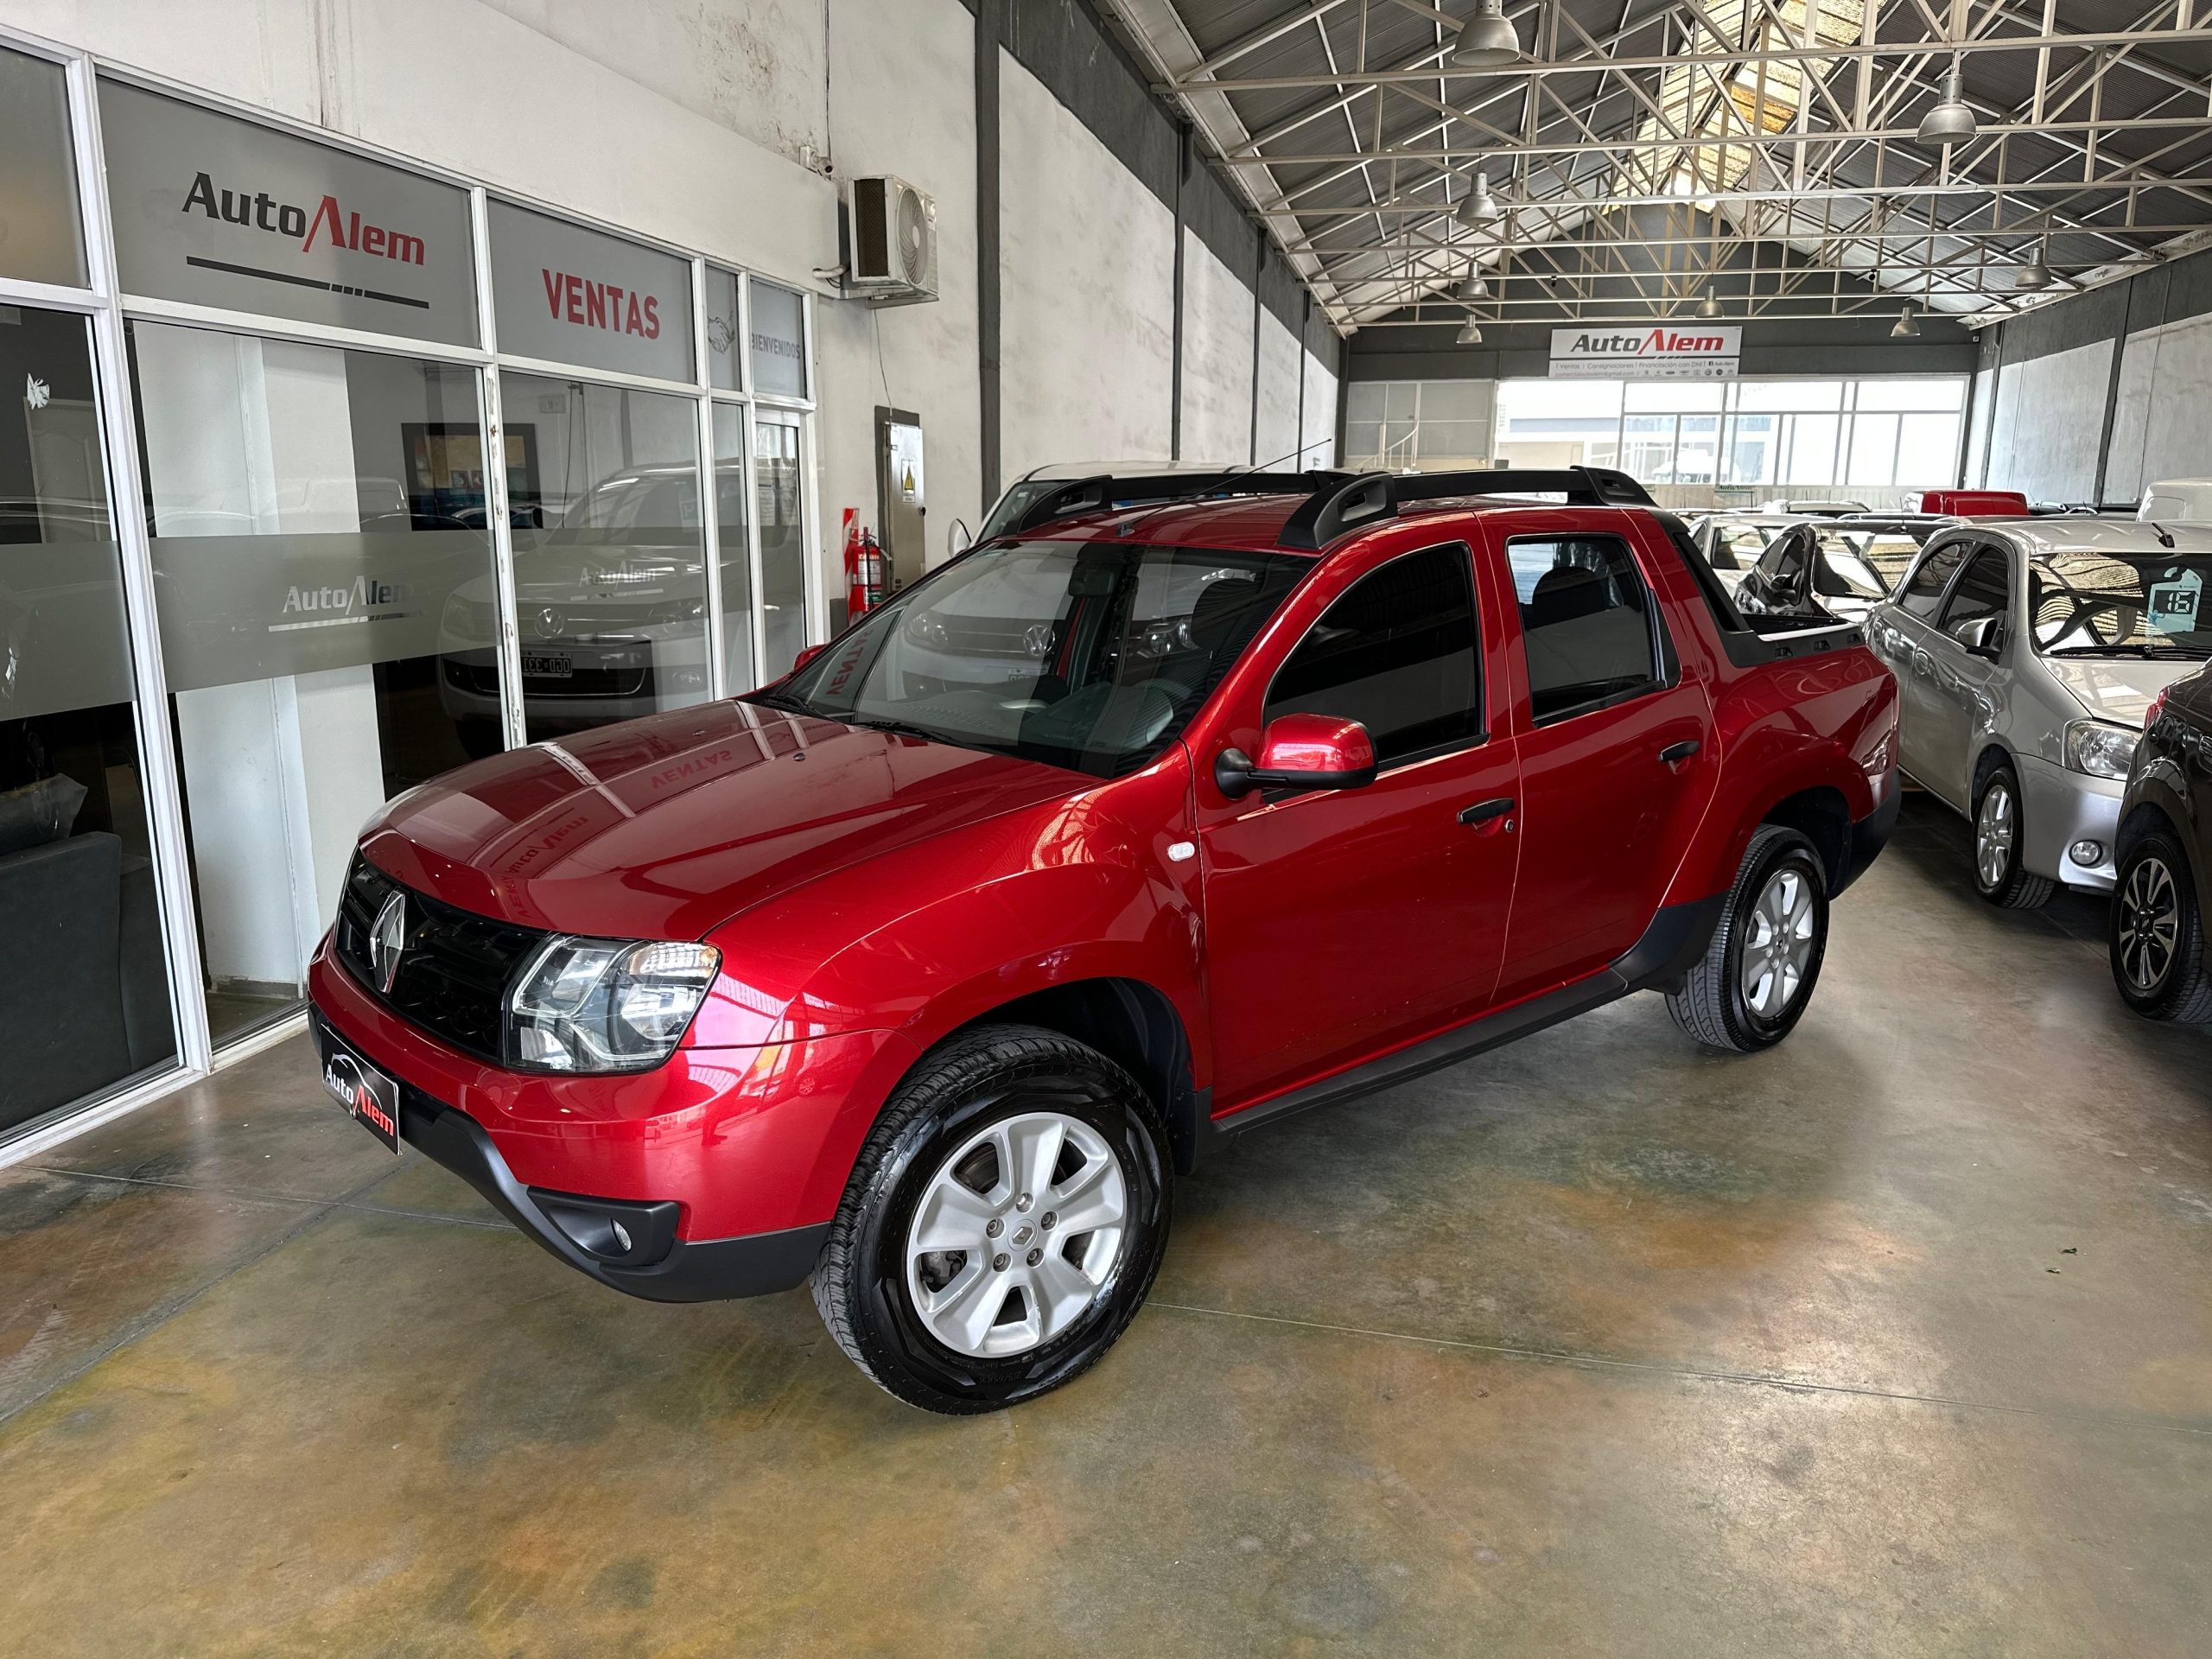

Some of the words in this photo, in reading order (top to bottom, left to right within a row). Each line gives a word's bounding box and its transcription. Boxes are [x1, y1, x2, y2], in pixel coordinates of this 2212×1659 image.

[542, 269, 661, 340] VENTAS
[1570, 329, 1724, 354] AutoAlem
[1586, 362, 1635, 371] Consignaciones
[2167, 592, 2191, 613] 16
[325, 1064, 394, 1137] AutoAlem
